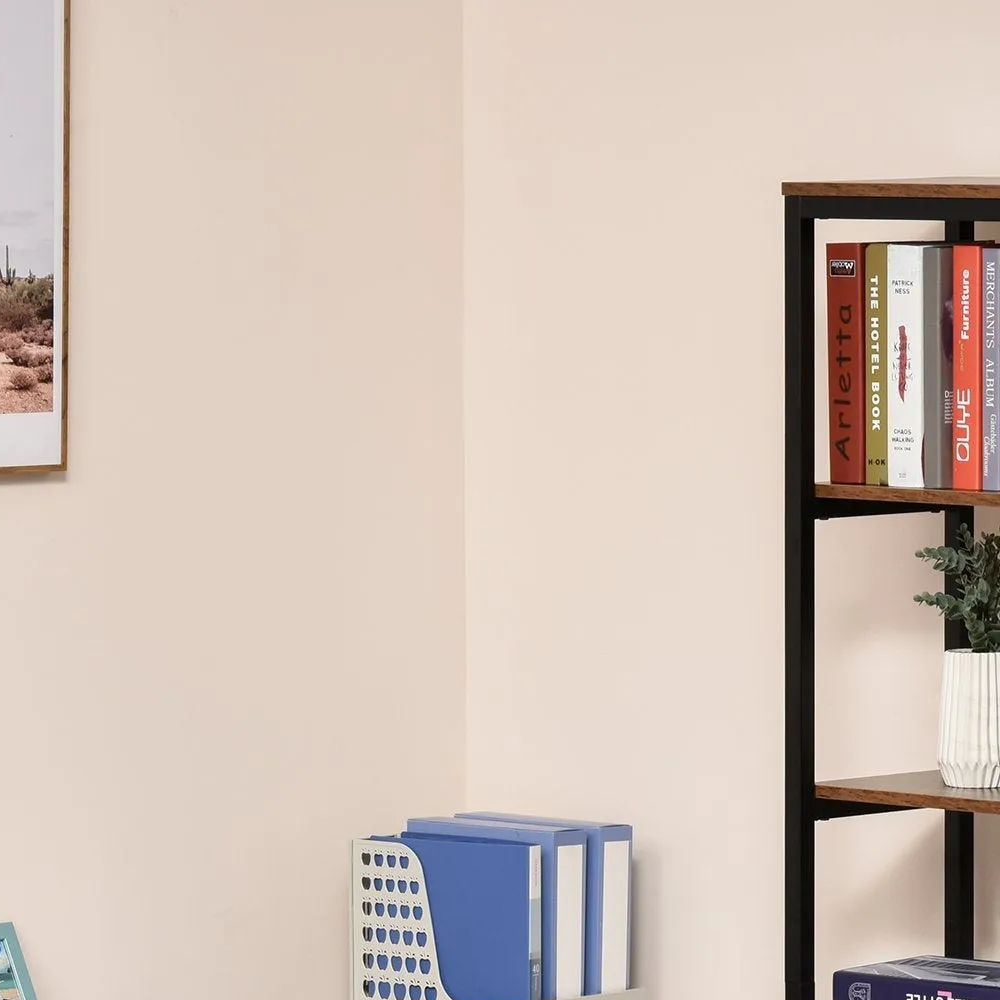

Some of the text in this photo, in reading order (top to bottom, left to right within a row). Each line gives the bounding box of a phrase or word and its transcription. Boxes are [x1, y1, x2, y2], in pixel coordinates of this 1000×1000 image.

[870, 275, 881, 431] THE HOTEL BOOK
[961, 269, 970, 340] Furniture
[985, 261, 996, 408] MERCHANTS ALBUM
[833, 304, 852, 461] Arletta
[893, 428, 912, 436] CHAOS
